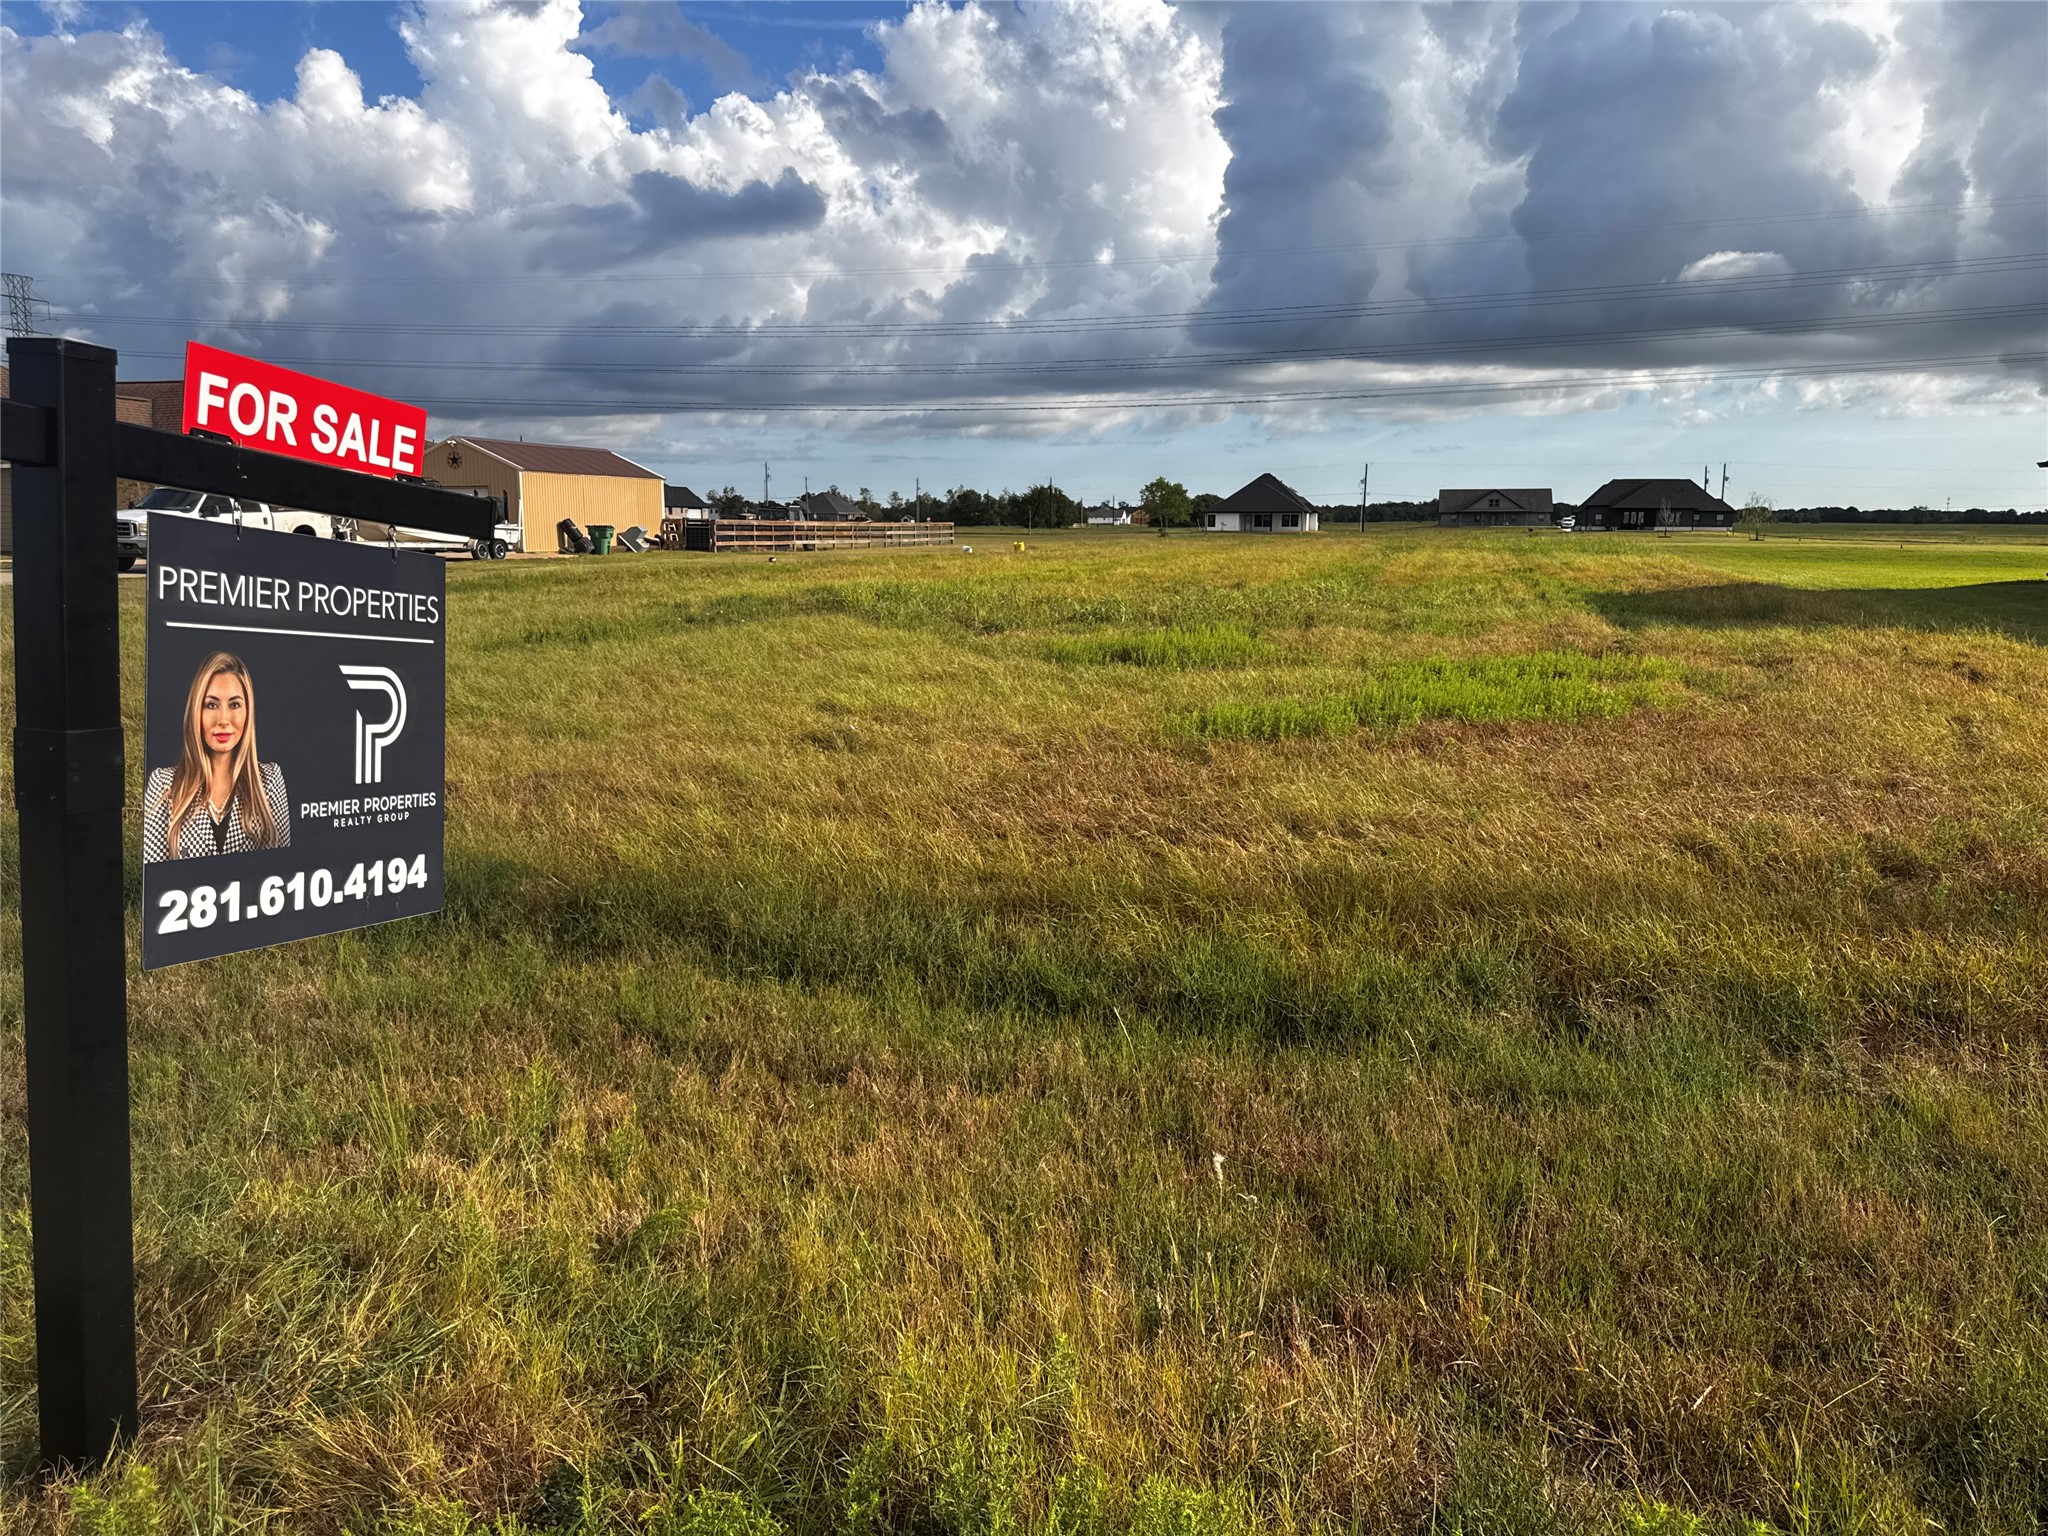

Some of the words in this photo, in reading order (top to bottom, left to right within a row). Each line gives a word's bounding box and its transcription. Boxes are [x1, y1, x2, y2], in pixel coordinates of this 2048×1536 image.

[197, 371, 298, 447] FOR
[310, 404, 418, 474] SALE
[159, 565, 291, 611] PREMIER
[298, 581, 439, 624] PROPERTIES
[300, 800, 360, 819] PREMIER
[363, 791, 437, 813] PROPERTIES
[333, 815, 372, 828] REALTY
[376, 811, 410, 824] GROUP
[157, 853, 428, 935] 281.610.4194
